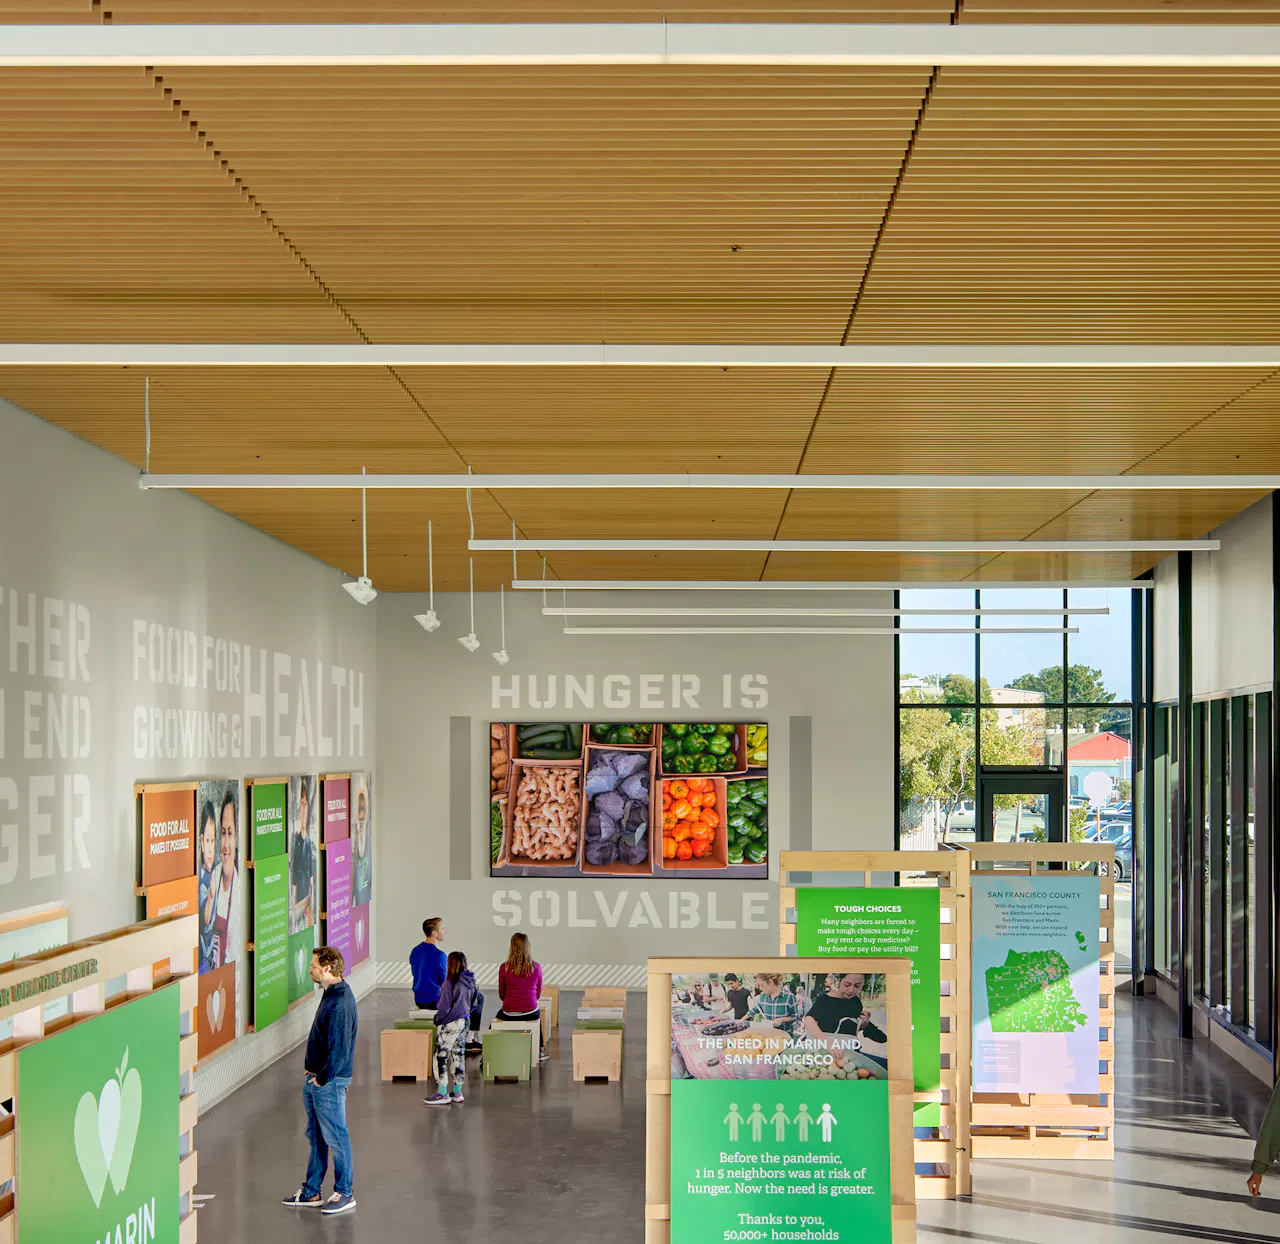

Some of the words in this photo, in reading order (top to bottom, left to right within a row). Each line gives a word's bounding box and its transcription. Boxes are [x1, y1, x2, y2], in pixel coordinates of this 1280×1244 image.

[133, 618, 198, 689] FOOD
[203, 636, 241, 693] FOR
[491, 674, 701, 709] HUNGER
[722, 674, 769, 709] IS
[243, 644, 364, 758] HEALTH
[24, 690, 91, 761] END
[133, 706, 228, 760] GROWING
[150, 821, 167, 838] FOOD
[168, 821, 178, 835] FOR
[179, 819, 189, 833] ALL
[150, 841, 165, 855] MAKES
[170, 838, 189, 851] POSSIBLE
[491, 889, 770, 930] SOLVABLE
[821, 919, 839, 927] Many
[841, 918, 873, 926] neighbors
[836, 928, 855, 936] tough
[902, 928, 913, 936] day
[864, 937, 876, 945] buy
[818, 946, 830, 954] Buy
[883, 946, 903, 954] utility
[12, 971, 62, 1003] WELCOME
[62, 958, 99, 985] CENTER
[697, 1038, 723, 1050] THE
[726, 1038, 761, 1050] NEED
[765, 1039, 779, 1050] IN
[783, 1038, 827, 1049] MARIN
[831, 1039, 861, 1050] AND
[724, 1054, 753, 1065] SAN
[756, 1054, 833, 1065] FRANCISCO
[719, 1153, 757, 1163] Before
[760, 1153, 780, 1163] the
[783, 1153, 842, 1166] pandemic,
[696, 1169, 700, 1179] 1
[703, 1168, 714, 1179] in
[718, 1170, 724, 1181] 5
[727, 1168, 785, 1182] neighbors
[788, 1171, 810, 1179] was
[814, 1169, 825, 1179] at
[829, 1168, 850, 1179] risk
[853, 1168, 866, 1179] of
[687, 1183, 732, 1197] hunger.
[735, 1183, 762, 1194] Now
[765, 1183, 784, 1194] the
[787, 1183, 815, 1194] need
[818, 1184, 828, 1194] is
[830, 1184, 875, 1197] greater.
[738, 1214, 781, 1224] Thanks
[785, 1216, 796, 1224] to
[799, 1217, 824, 1228] you,
[724, 1230, 768, 1242] 50,000+
[771, 1229, 839, 1240] households
